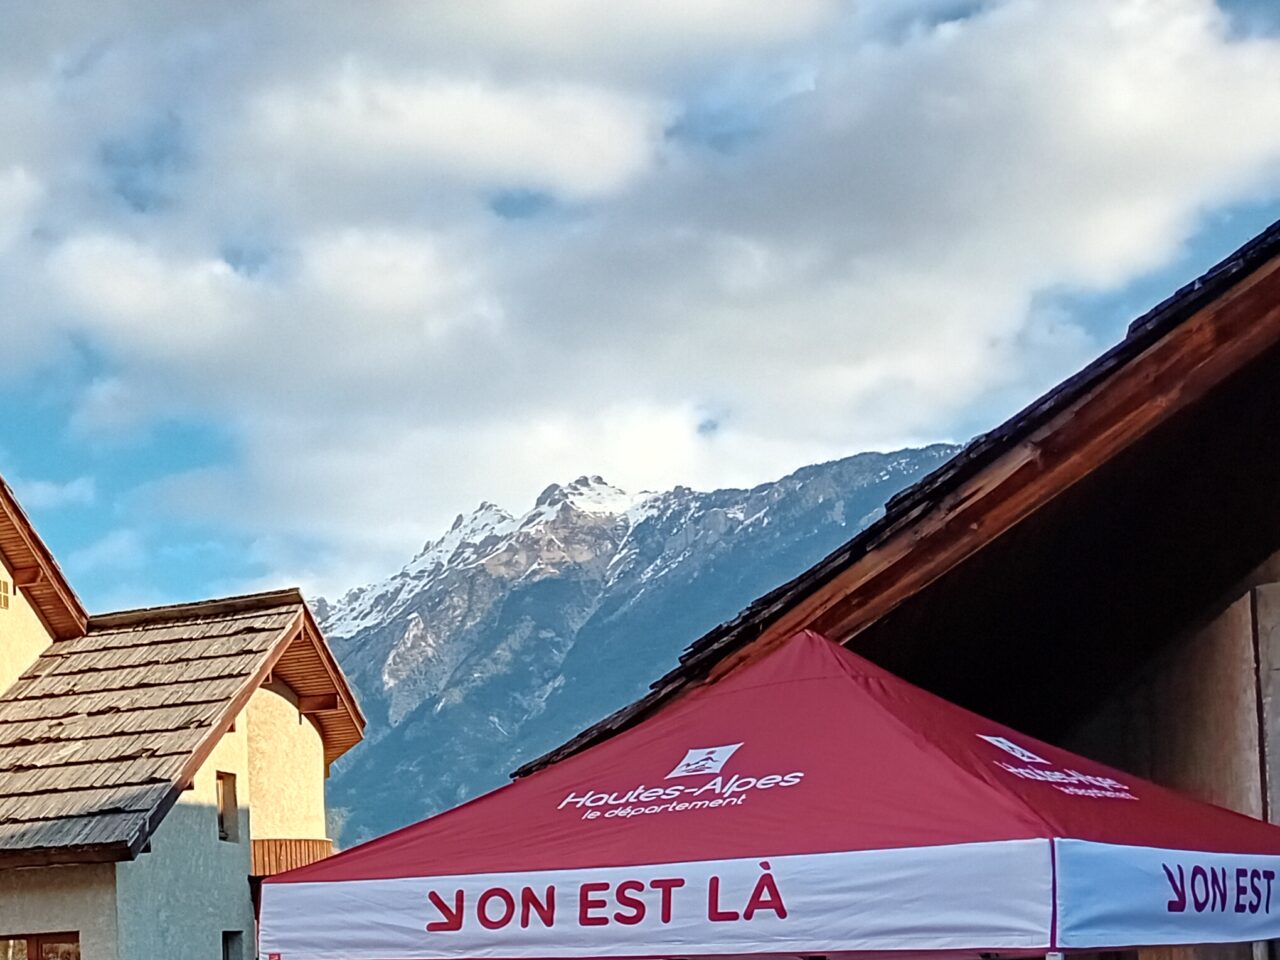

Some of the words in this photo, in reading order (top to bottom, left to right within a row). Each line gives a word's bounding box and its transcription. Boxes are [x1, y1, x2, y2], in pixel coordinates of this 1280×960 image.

[557, 771, 805, 809] Hautes-Alpes
[581, 808, 601, 820] le
[603, 793, 747, 819] département
[476, 885, 556, 930] ON
[578, 877, 686, 927] EST
[707, 861, 789, 922] LÀ
[1190, 864, 1228, 913] ON
[1234, 867, 1276, 914] EST
